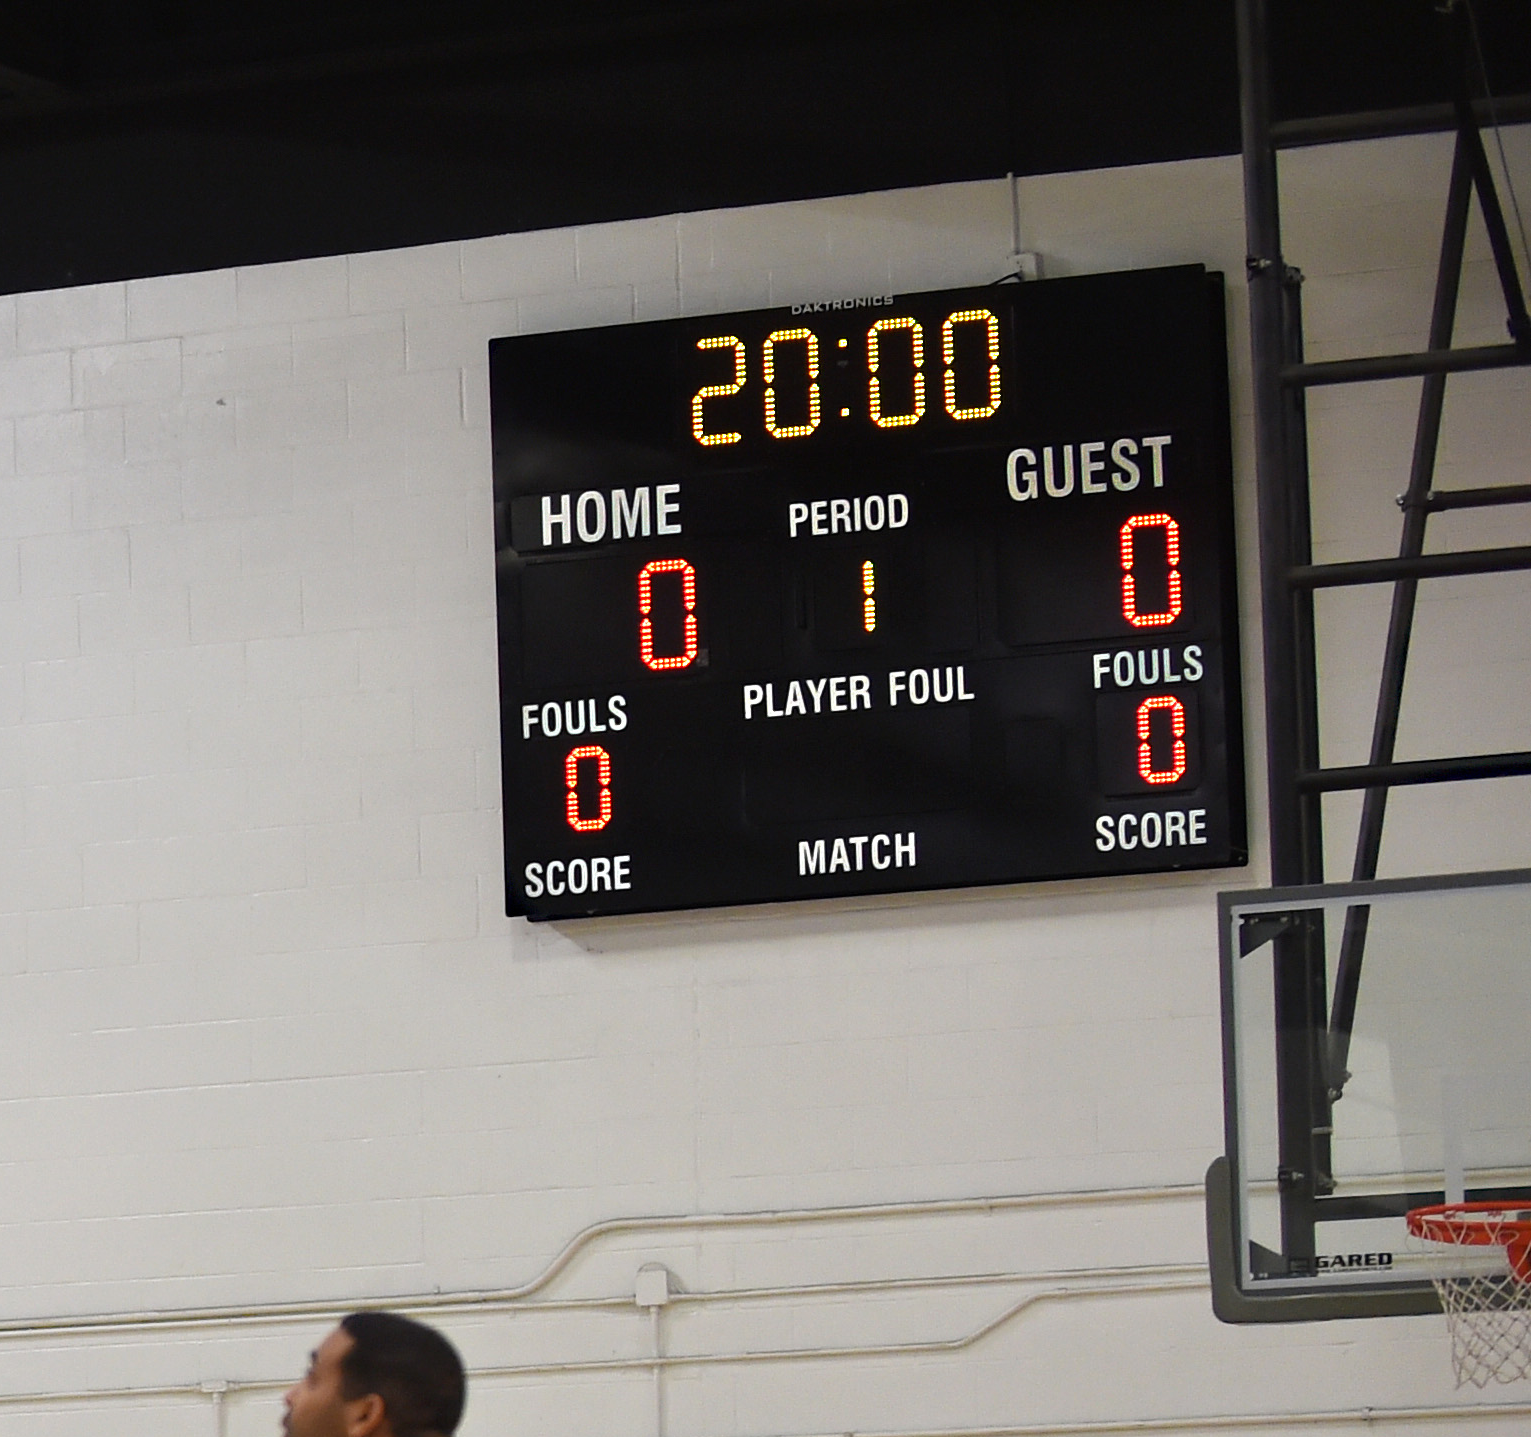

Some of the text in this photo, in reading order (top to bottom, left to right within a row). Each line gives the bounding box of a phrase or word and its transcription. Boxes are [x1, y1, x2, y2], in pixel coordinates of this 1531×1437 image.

[791, 296, 894, 315] DAKTRONICS
[692, 309, 1001, 446] 20:00
[1006, 435, 1173, 502] GUEST
[540, 483, 682, 547] HOME
[789, 493, 909, 538] PERIOD
[862, 560, 876, 632] 1
[1119, 513, 1182, 628] 0
[638, 558, 698, 671] 0
[743, 666, 975, 720] PLAYER FOUL
[1092, 645, 1204, 689] FOULS
[522, 695, 628, 740] FOULS
[1136, 695, 1186, 785] 0
[565, 745, 612, 832] 0
[798, 832, 917, 876] MATCH
[1095, 808, 1207, 852] SCORE
[524, 855, 632, 898] SCORE
[1315, 1253, 1393, 1268] GARED
